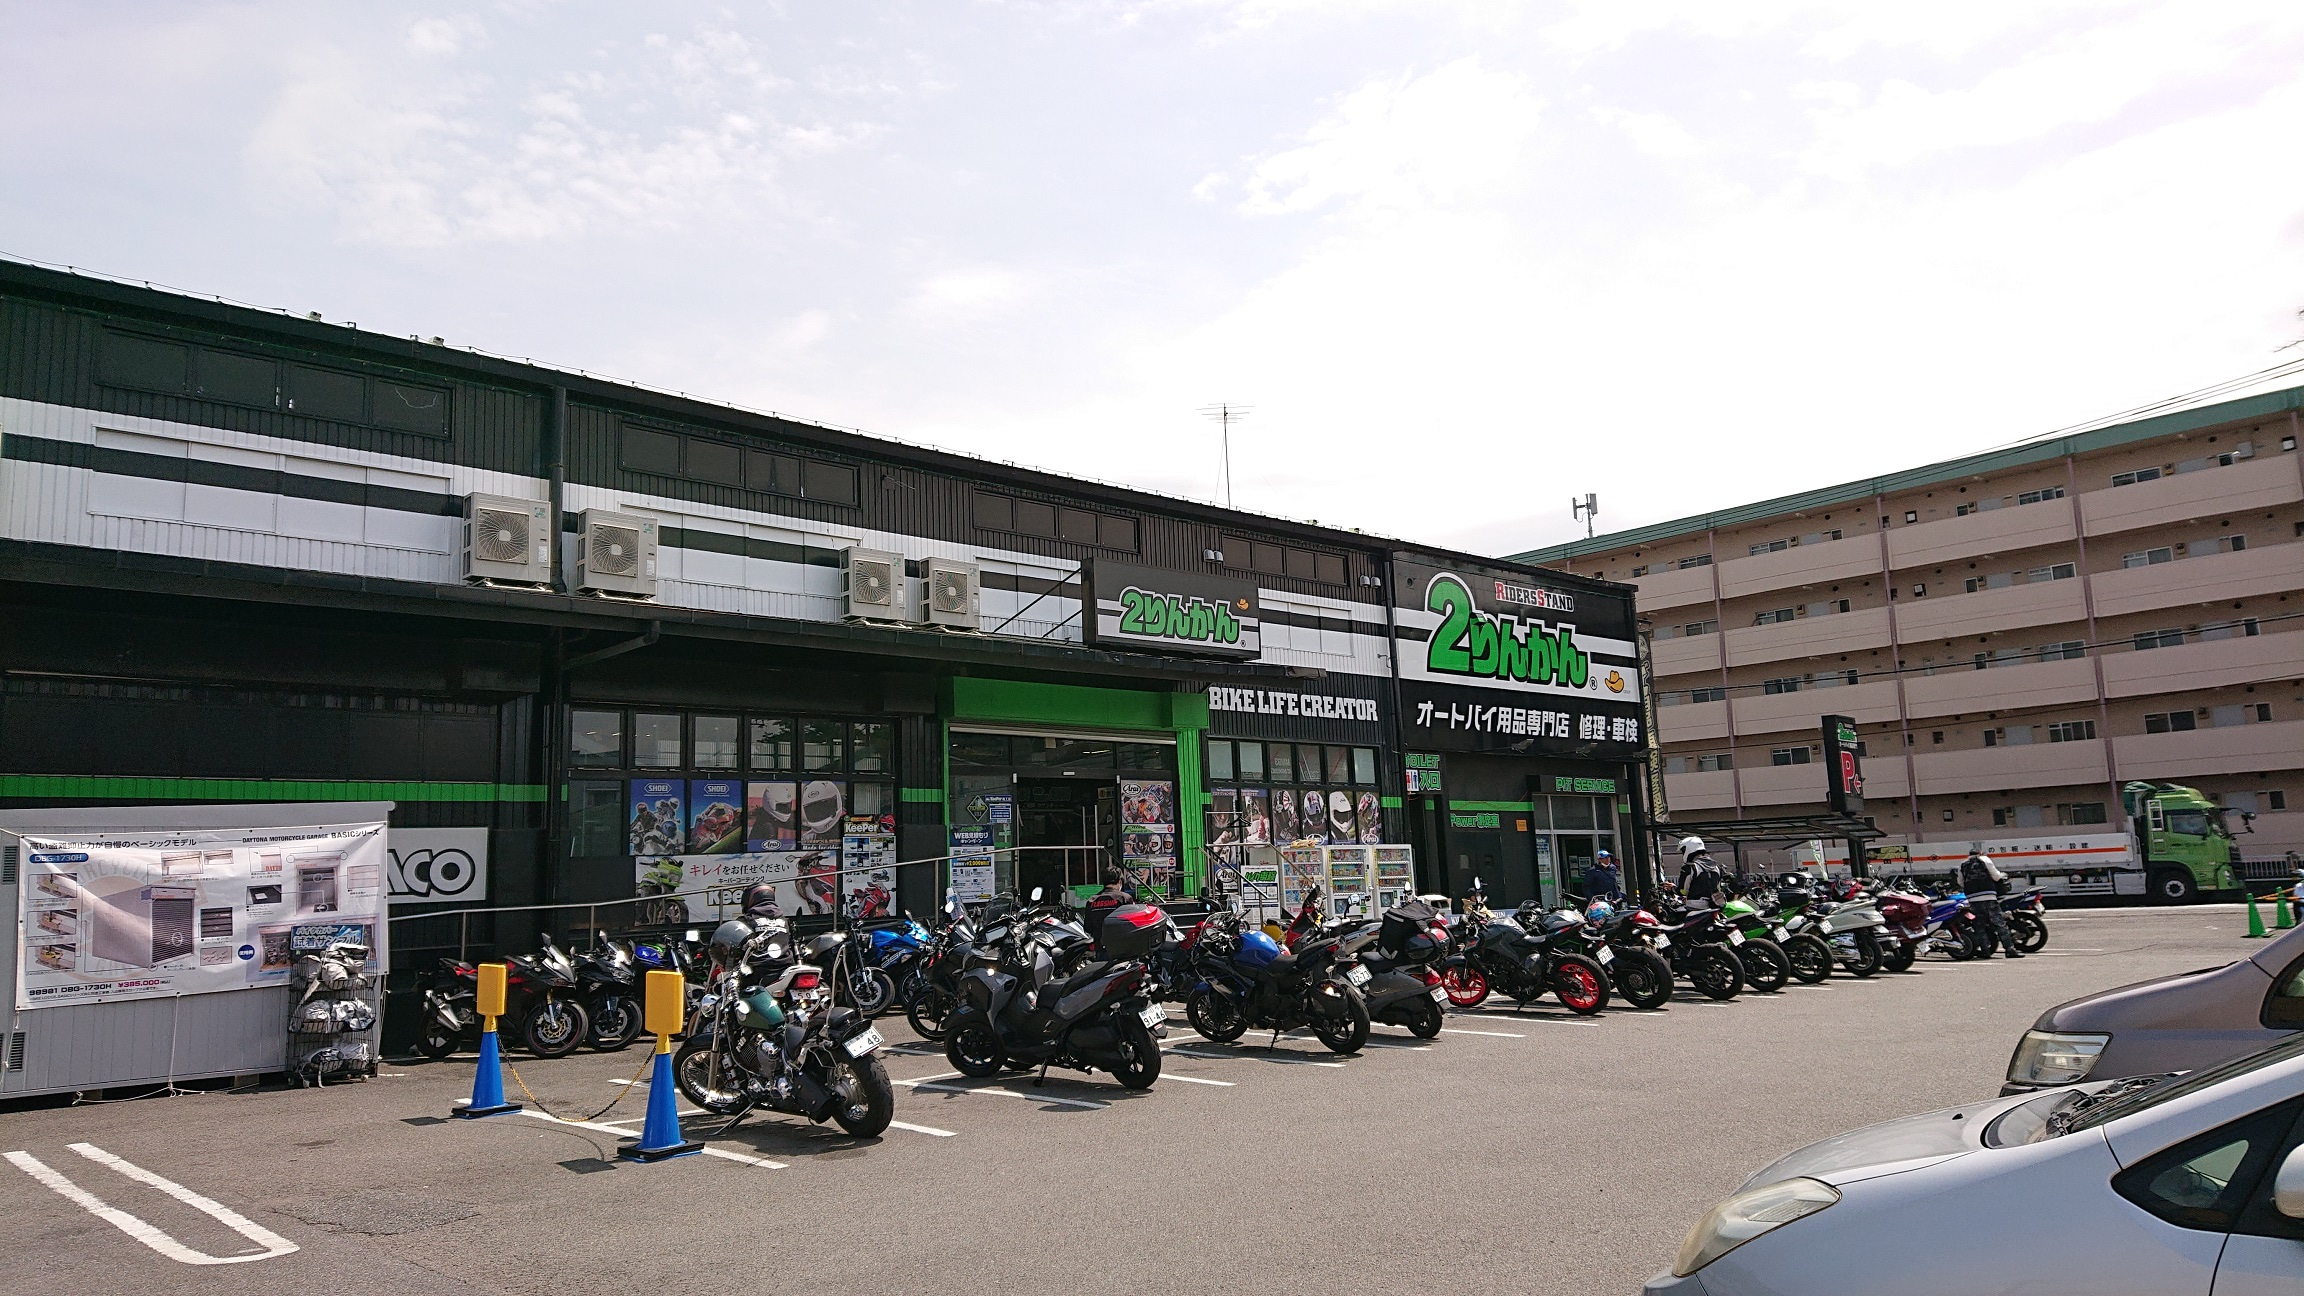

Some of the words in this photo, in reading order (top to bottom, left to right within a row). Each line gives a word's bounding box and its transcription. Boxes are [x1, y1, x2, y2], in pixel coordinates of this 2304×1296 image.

[1495, 582, 1537, 605] RIDERS
[1537, 590, 1574, 612] STAND
[1120, 588, 1240, 645] 2りんかん
[1426, 574, 1589, 690] 2りんかん
[1208, 686, 1255, 713] BIKE
[1257, 690, 1299, 716] LIFE
[1300, 694, 1379, 722] CREATOR
[1416, 700, 1570, 738] オートバイ用品専門店
[1579, 713, 1638, 743] 修理・車検
[1404, 753, 1440, 769] TOILET
[1419, 770, 1441, 791] 入口
[1841, 750, 1856, 794] P
[707, 785, 726, 793] SHOEI
[1555, 776, 1573, 791] PIT
[1574, 777, 1616, 793] SERVICE
[331, 829, 380, 839] BASICシリーズ
[845, 822, 878, 833] KeePer
[690, 863, 790, 877] キレイをお任せください
[709, 888, 744, 906] Kee
[295, 926, 339, 935] バイクカバー
